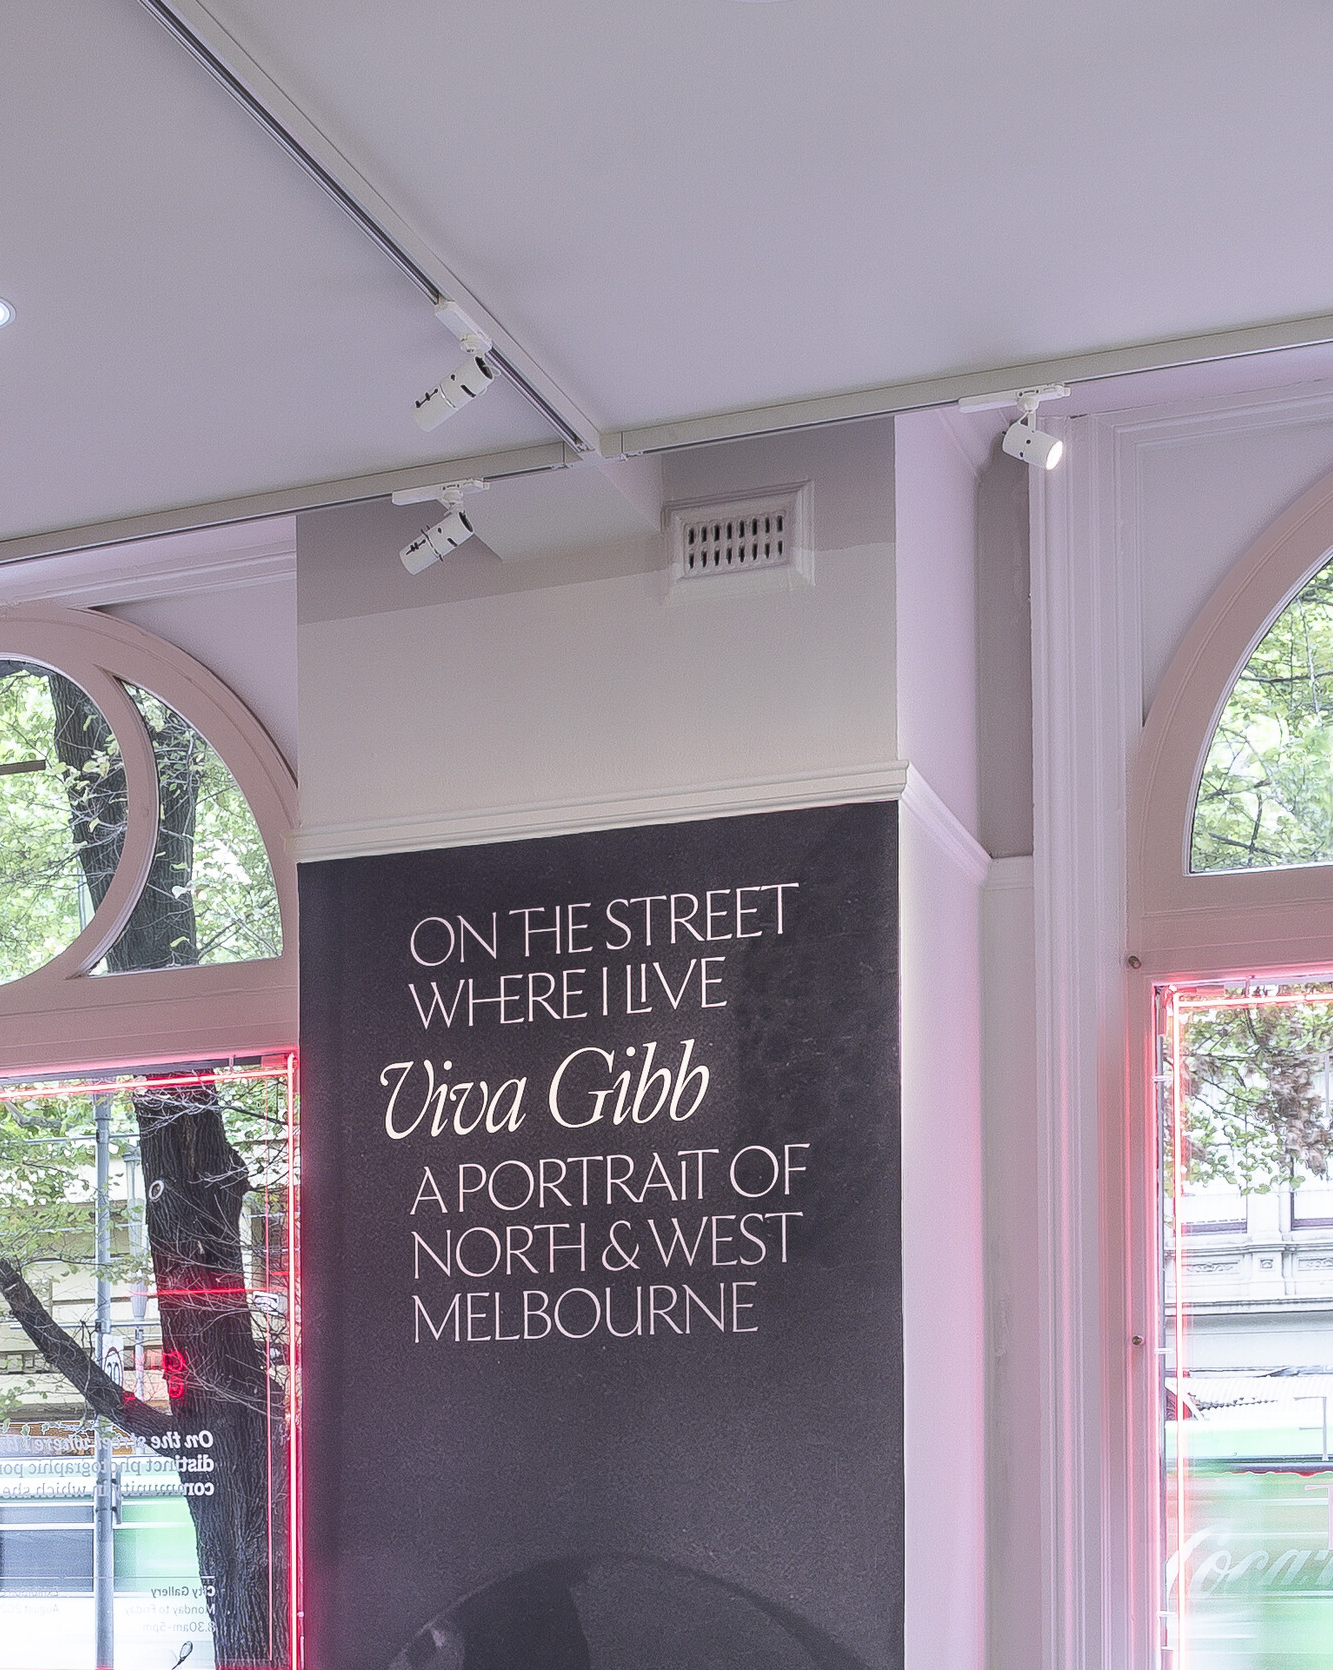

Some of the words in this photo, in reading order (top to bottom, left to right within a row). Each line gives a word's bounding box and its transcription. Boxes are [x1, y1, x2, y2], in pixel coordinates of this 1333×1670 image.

[410, 911, 497, 967] ON
[509, 903, 593, 957] THE
[605, 882, 800, 951] STREET
[408, 968, 588, 1029] WHERE
[602, 966, 608, 1016] I
[626, 956, 728, 1015] LIVE
[379, 1059, 528, 1140] Viva
[547, 1038, 710, 1129] Gibb
[409, 1166, 448, 1216] A
[457, 1148, 720, 1213] PORTRAIT
[730, 1143, 810, 1198] OF
[410, 1222, 586, 1280] NORTH
[601, 1220, 640, 1271] &
[647, 1212, 804, 1268] WEST
[412, 1281, 758, 1343] MELBOURNE
